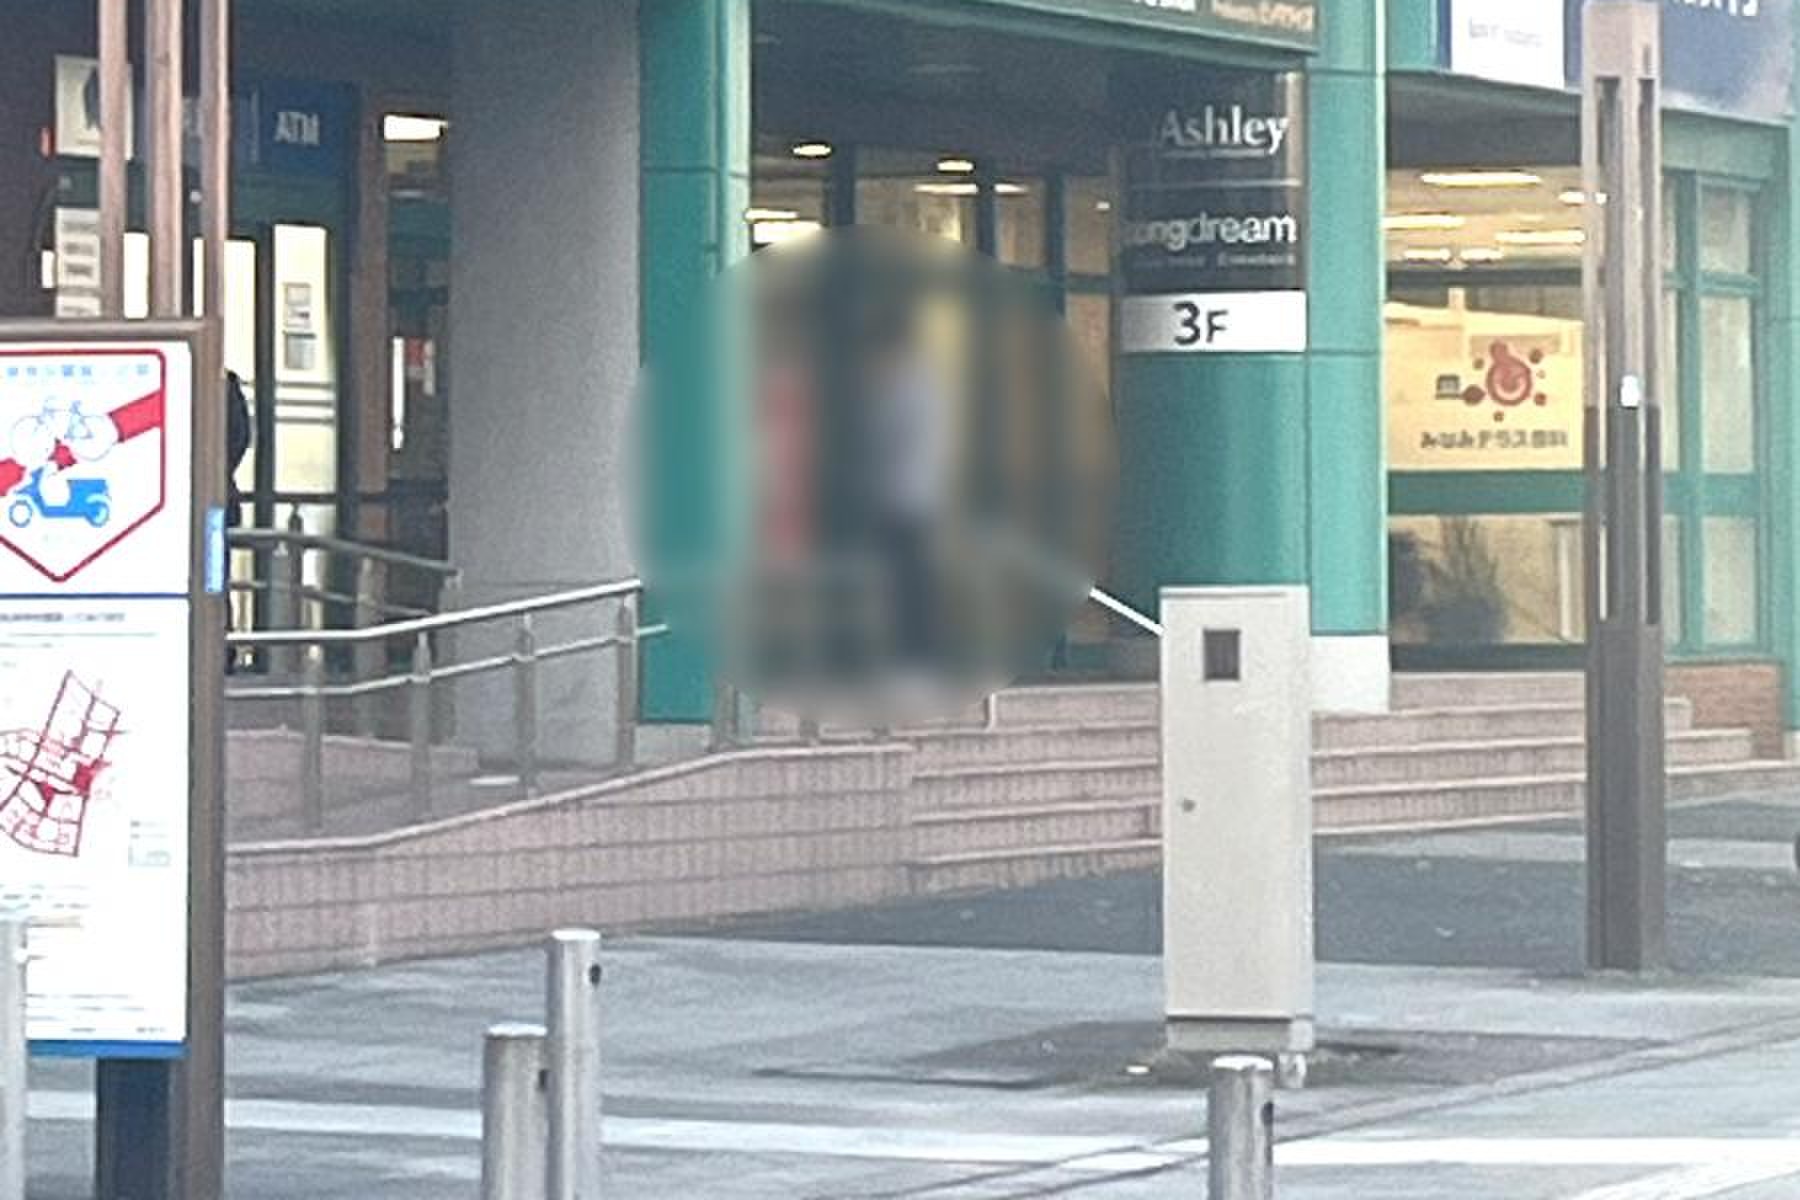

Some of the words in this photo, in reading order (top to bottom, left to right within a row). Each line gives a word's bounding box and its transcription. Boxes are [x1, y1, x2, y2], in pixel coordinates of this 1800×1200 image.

[274, 111, 320, 146] ATM
[1160, 105, 1288, 155] Ashley
[1130, 211, 1297, 251] ongdream
[1173, 300, 1229, 346] 3F
